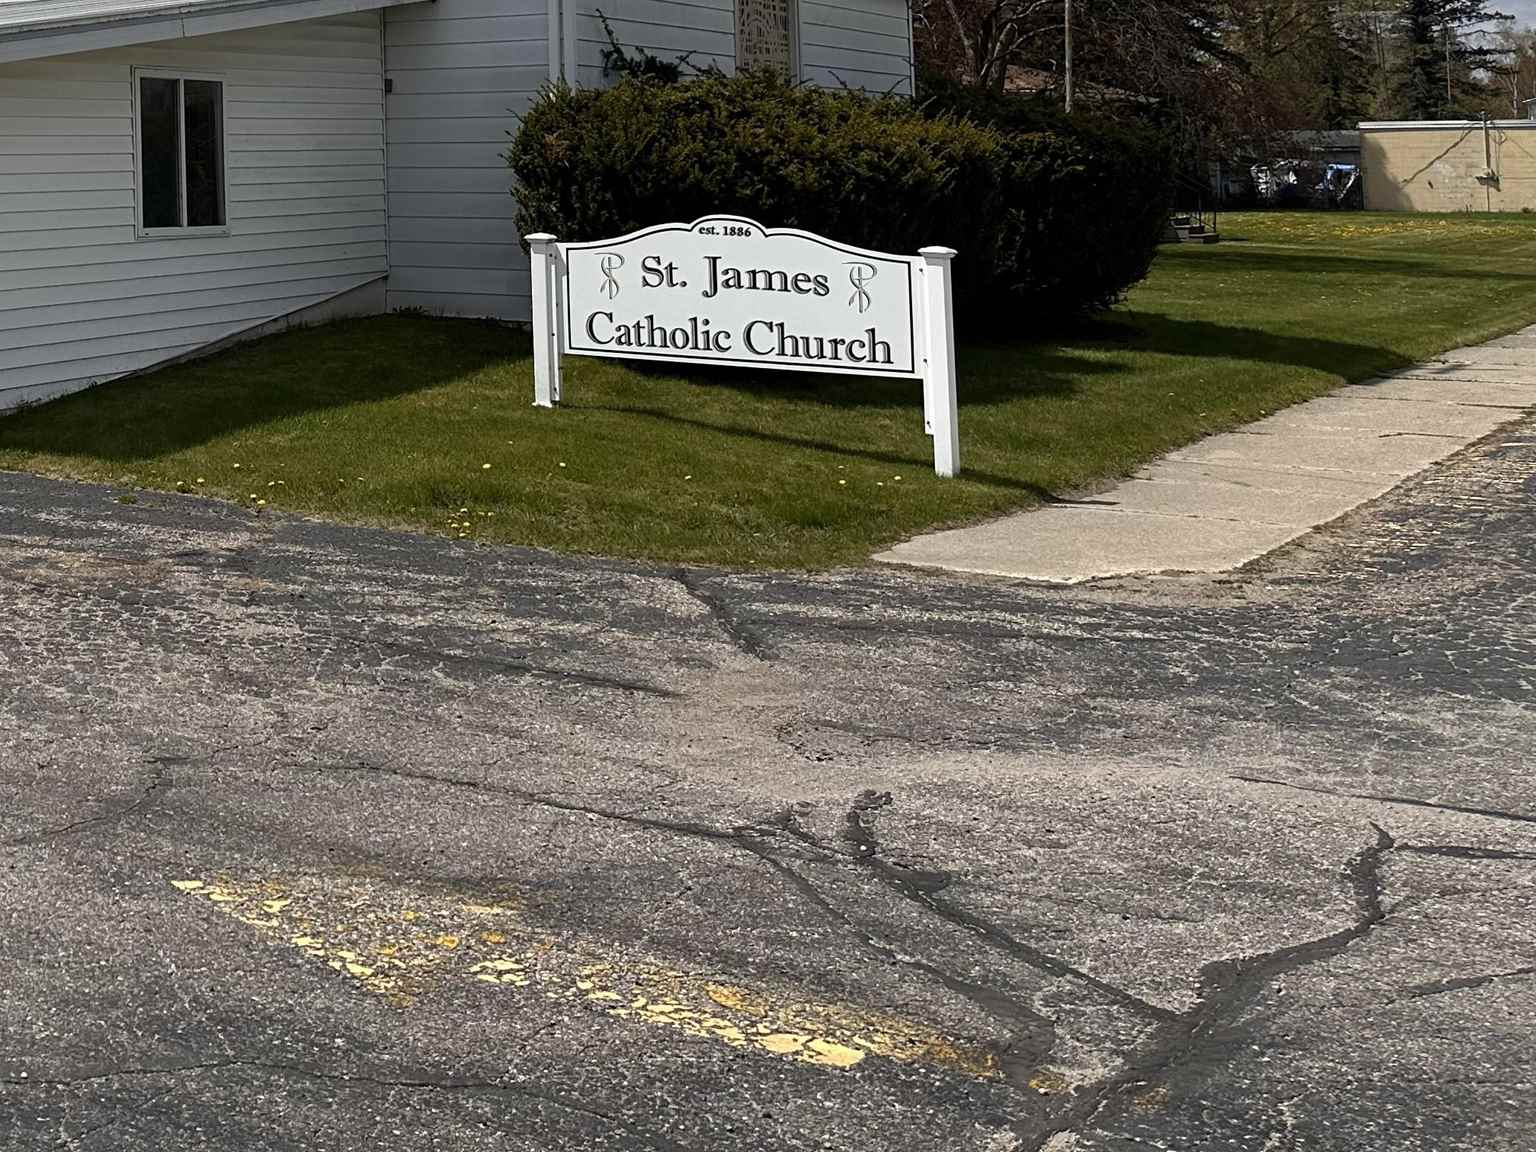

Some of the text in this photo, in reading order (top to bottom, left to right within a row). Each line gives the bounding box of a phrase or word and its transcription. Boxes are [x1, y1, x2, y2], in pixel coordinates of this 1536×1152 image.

[698, 225, 752, 237] est. 1886
[641, 256, 830, 298] St. James
[585, 312, 894, 364] Catholic Church
